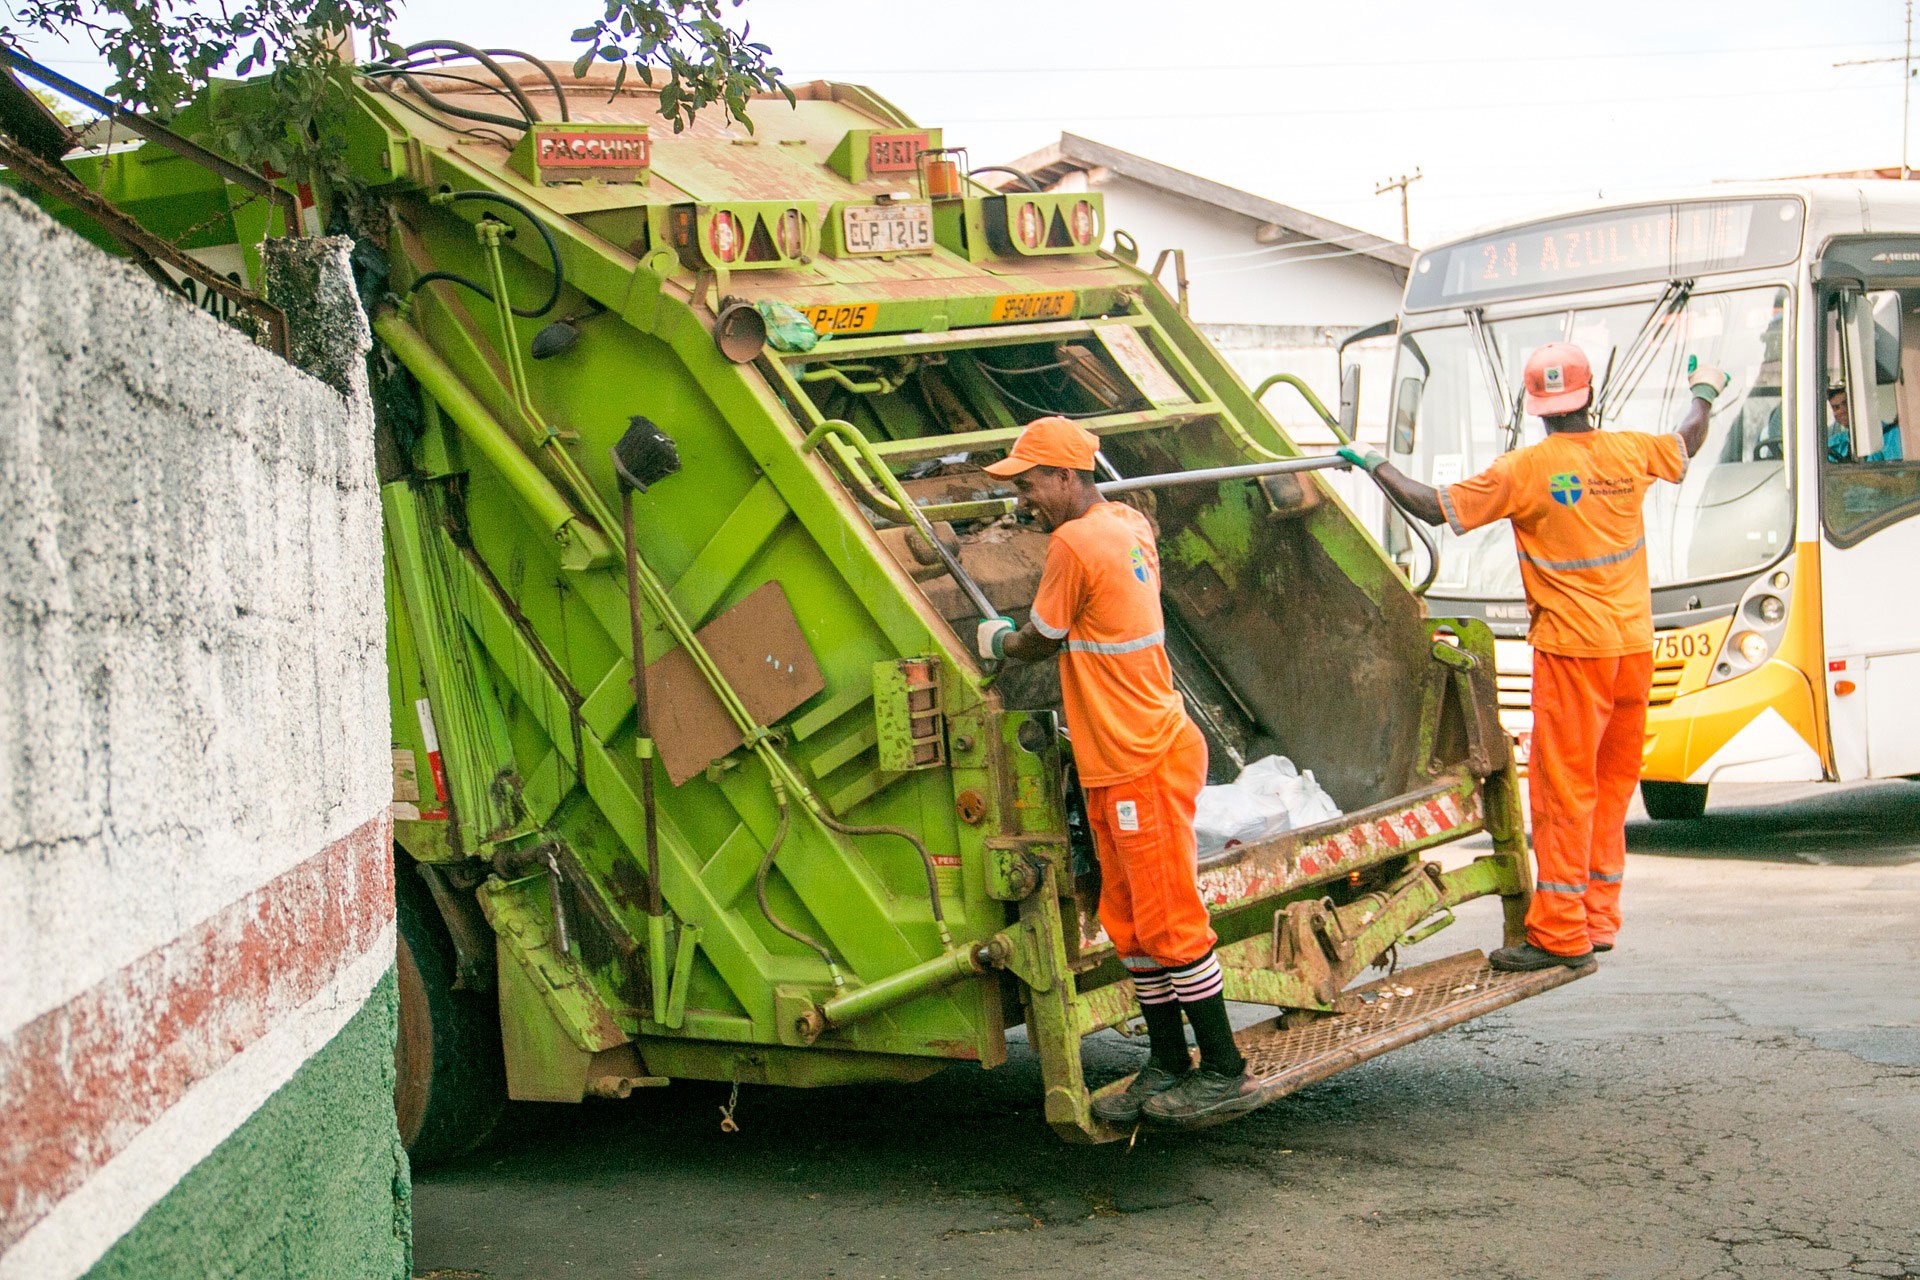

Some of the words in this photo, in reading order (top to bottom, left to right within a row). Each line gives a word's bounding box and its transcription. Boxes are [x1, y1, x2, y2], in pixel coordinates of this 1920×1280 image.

[541, 139, 645, 160] FACCHINI
[850, 222, 880, 248] CLP
[888, 220, 928, 244] 1215
[1485, 604, 1532, 619] NE
[1655, 634, 1711, 659] 7503
